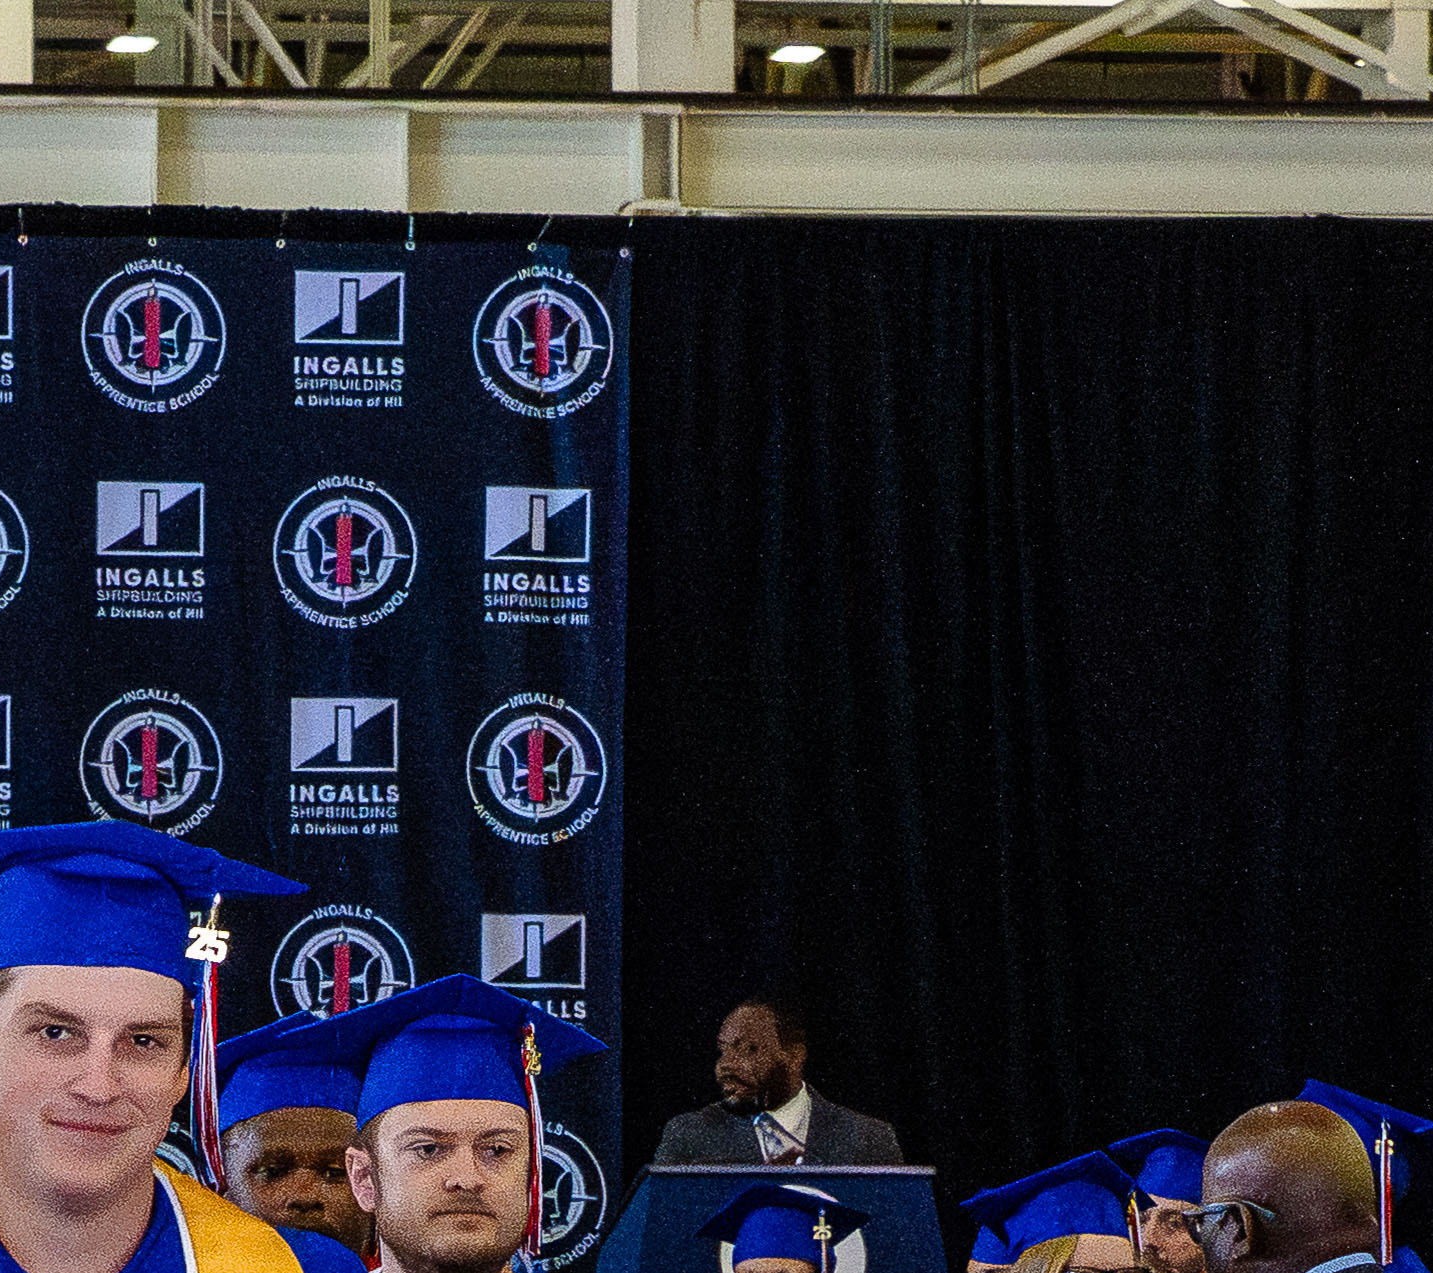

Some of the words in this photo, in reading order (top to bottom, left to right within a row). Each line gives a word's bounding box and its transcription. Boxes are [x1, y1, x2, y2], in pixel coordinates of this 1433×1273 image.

[125, 259, 184, 277] INGALLS
[293, 354, 405, 377] INGALLS
[89, 371, 167, 414] APPRENTICE
[166, 374, 219, 410] SCHOOL
[293, 377, 404, 392] SHIPBUILDING
[293, 394, 305, 407] A
[307, 394, 363, 407] Division
[367, 394, 381, 407] of
[317, 475, 376, 493] INGALLS
[95, 566, 205, 589] INGALLS
[484, 571, 590, 594] INGALLS
[95, 589, 204, 603] SHIPBUILDING
[483, 594, 589, 609] SHIPBUILDING
[280, 588, 358, 631] APPRENTICE
[357, 590, 410, 627] SCHOOL
[483, 610, 495, 623] A
[496, 611, 550, 624] Division
[554, 612, 567, 625] of
[508, 693, 566, 710] INGALLS
[290, 782, 399, 805] INGALLS
[290, 805, 398, 819] SHIPBUILDING
[290, 822, 301, 835] A
[303, 822, 358, 836] Division
[362, 822, 376, 835] of
[473, 804, 549, 847] APPRENTICE
[549, 807, 600, 844] SCHOOL
[185, 926, 230, 964] 25
